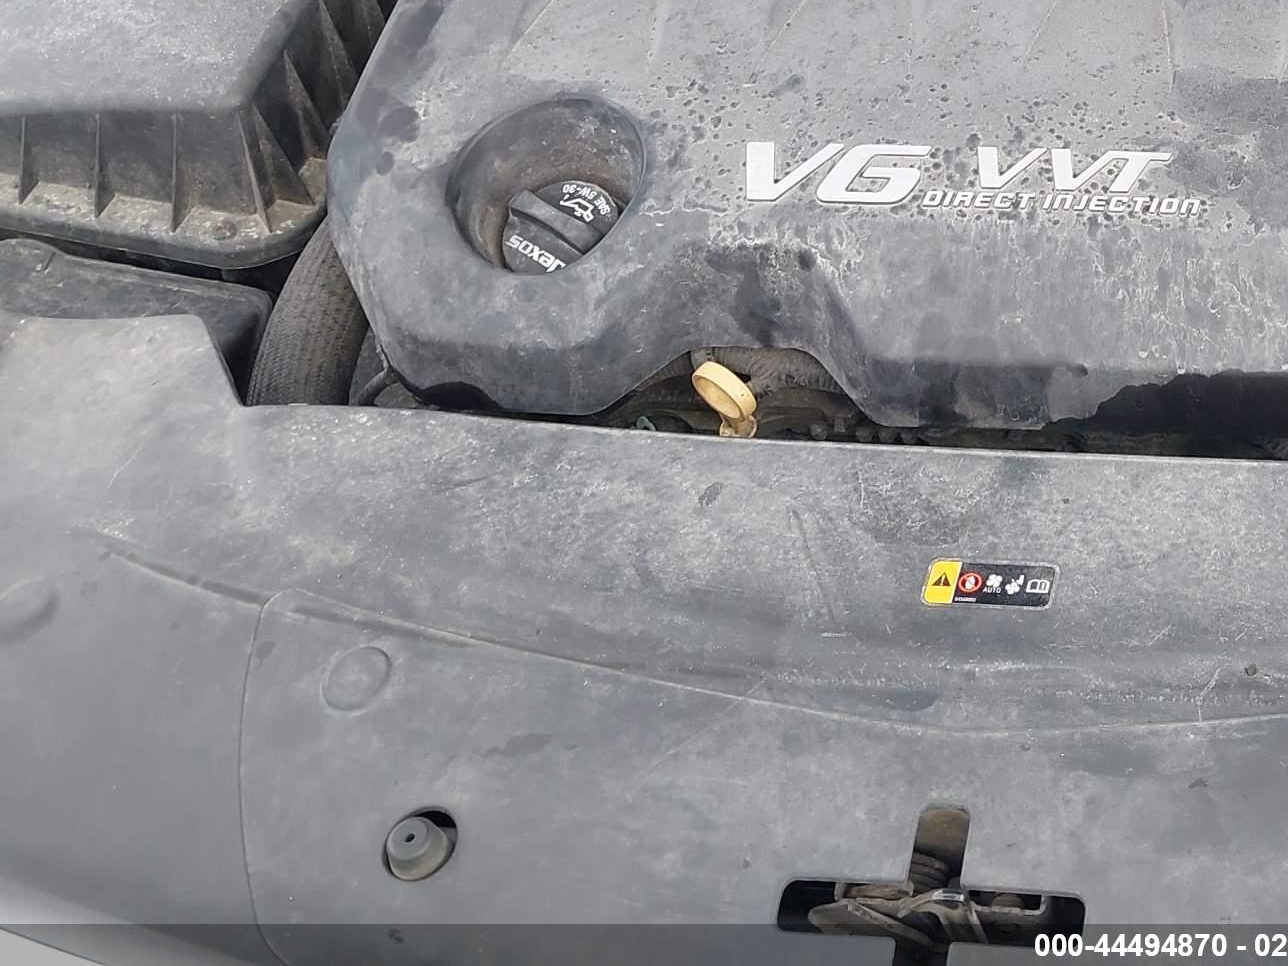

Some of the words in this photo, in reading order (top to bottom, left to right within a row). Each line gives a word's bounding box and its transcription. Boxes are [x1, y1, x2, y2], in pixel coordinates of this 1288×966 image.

[746, 142, 932, 204] V6
[977, 146, 1174, 194] VVT
[562, 184, 597, 198] 5W-30
[594, 196, 611, 215] SAE
[922, 190, 1036, 209] DIRECT
[1042, 193, 1201, 217] INJECTION
[982, 586, 1001, 594] AUTO
